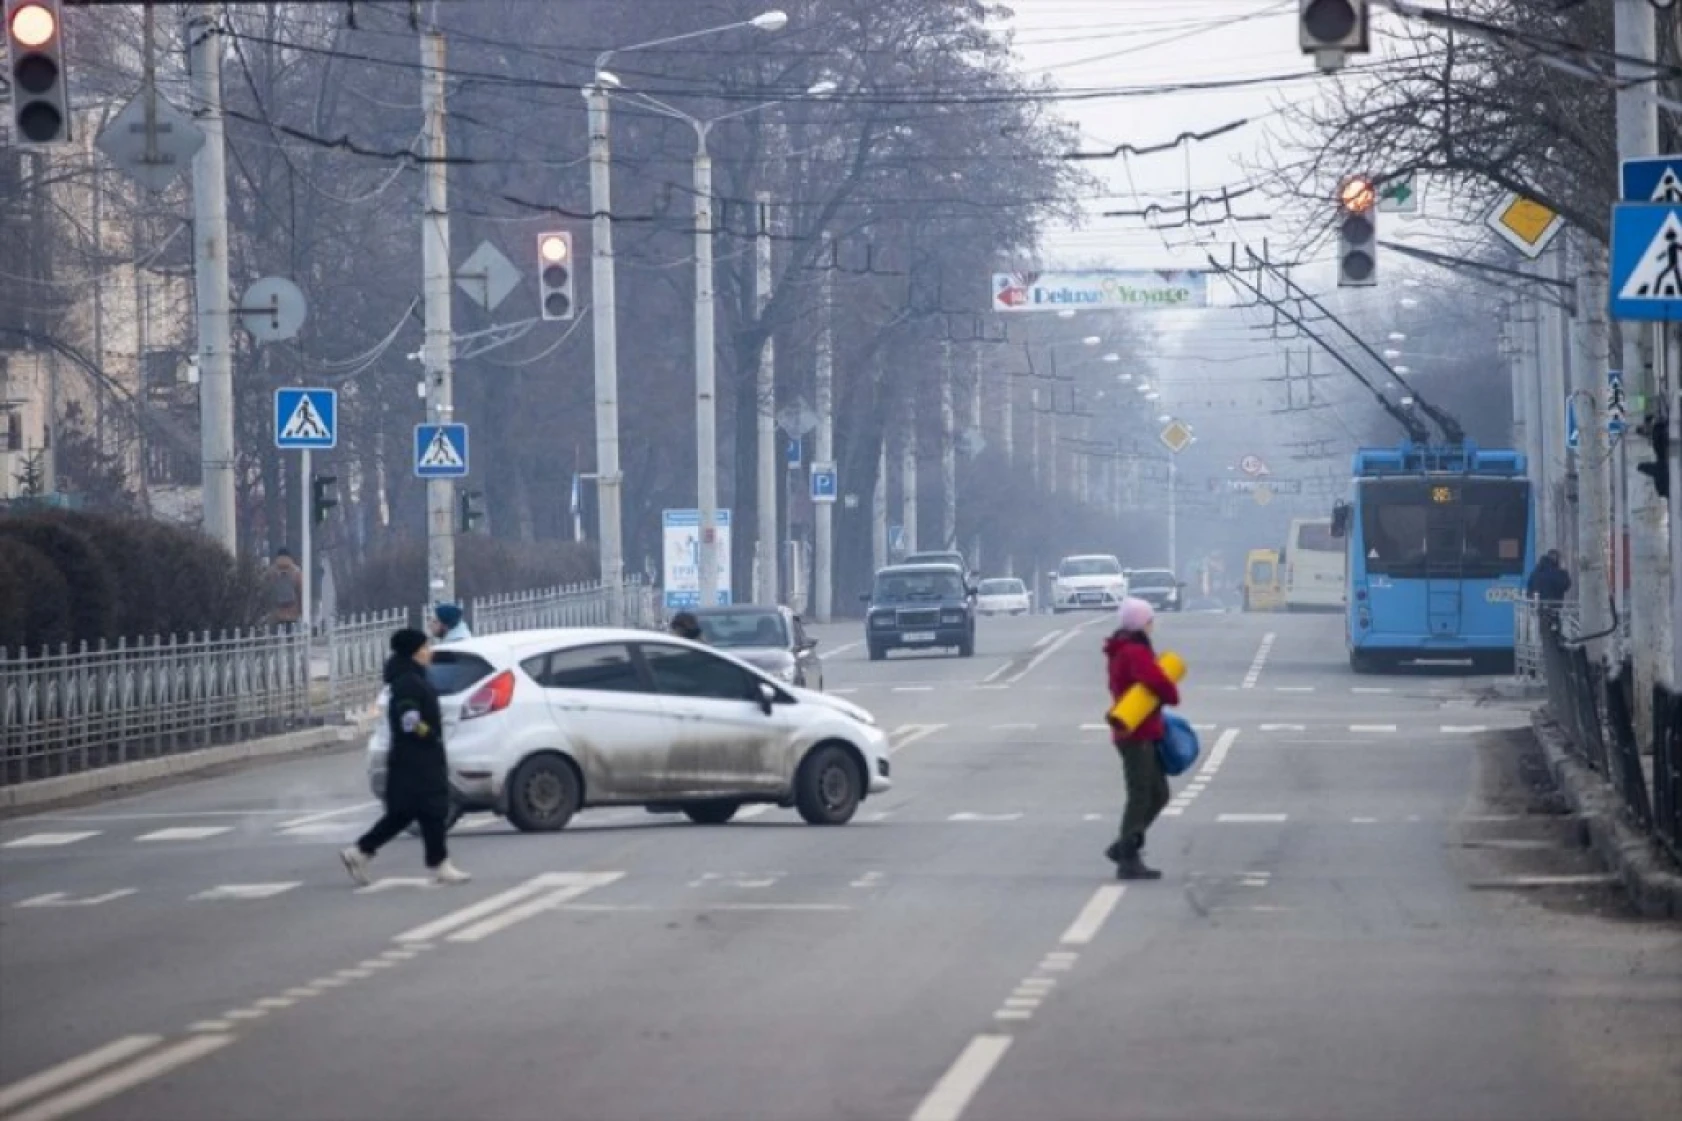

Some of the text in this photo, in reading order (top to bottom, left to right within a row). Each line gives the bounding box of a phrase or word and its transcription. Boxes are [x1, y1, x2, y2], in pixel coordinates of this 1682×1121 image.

[1034, 286, 1103, 305] Deluxe
[1117, 284, 1190, 307] Voyage
[816, 475, 830, 495] P
